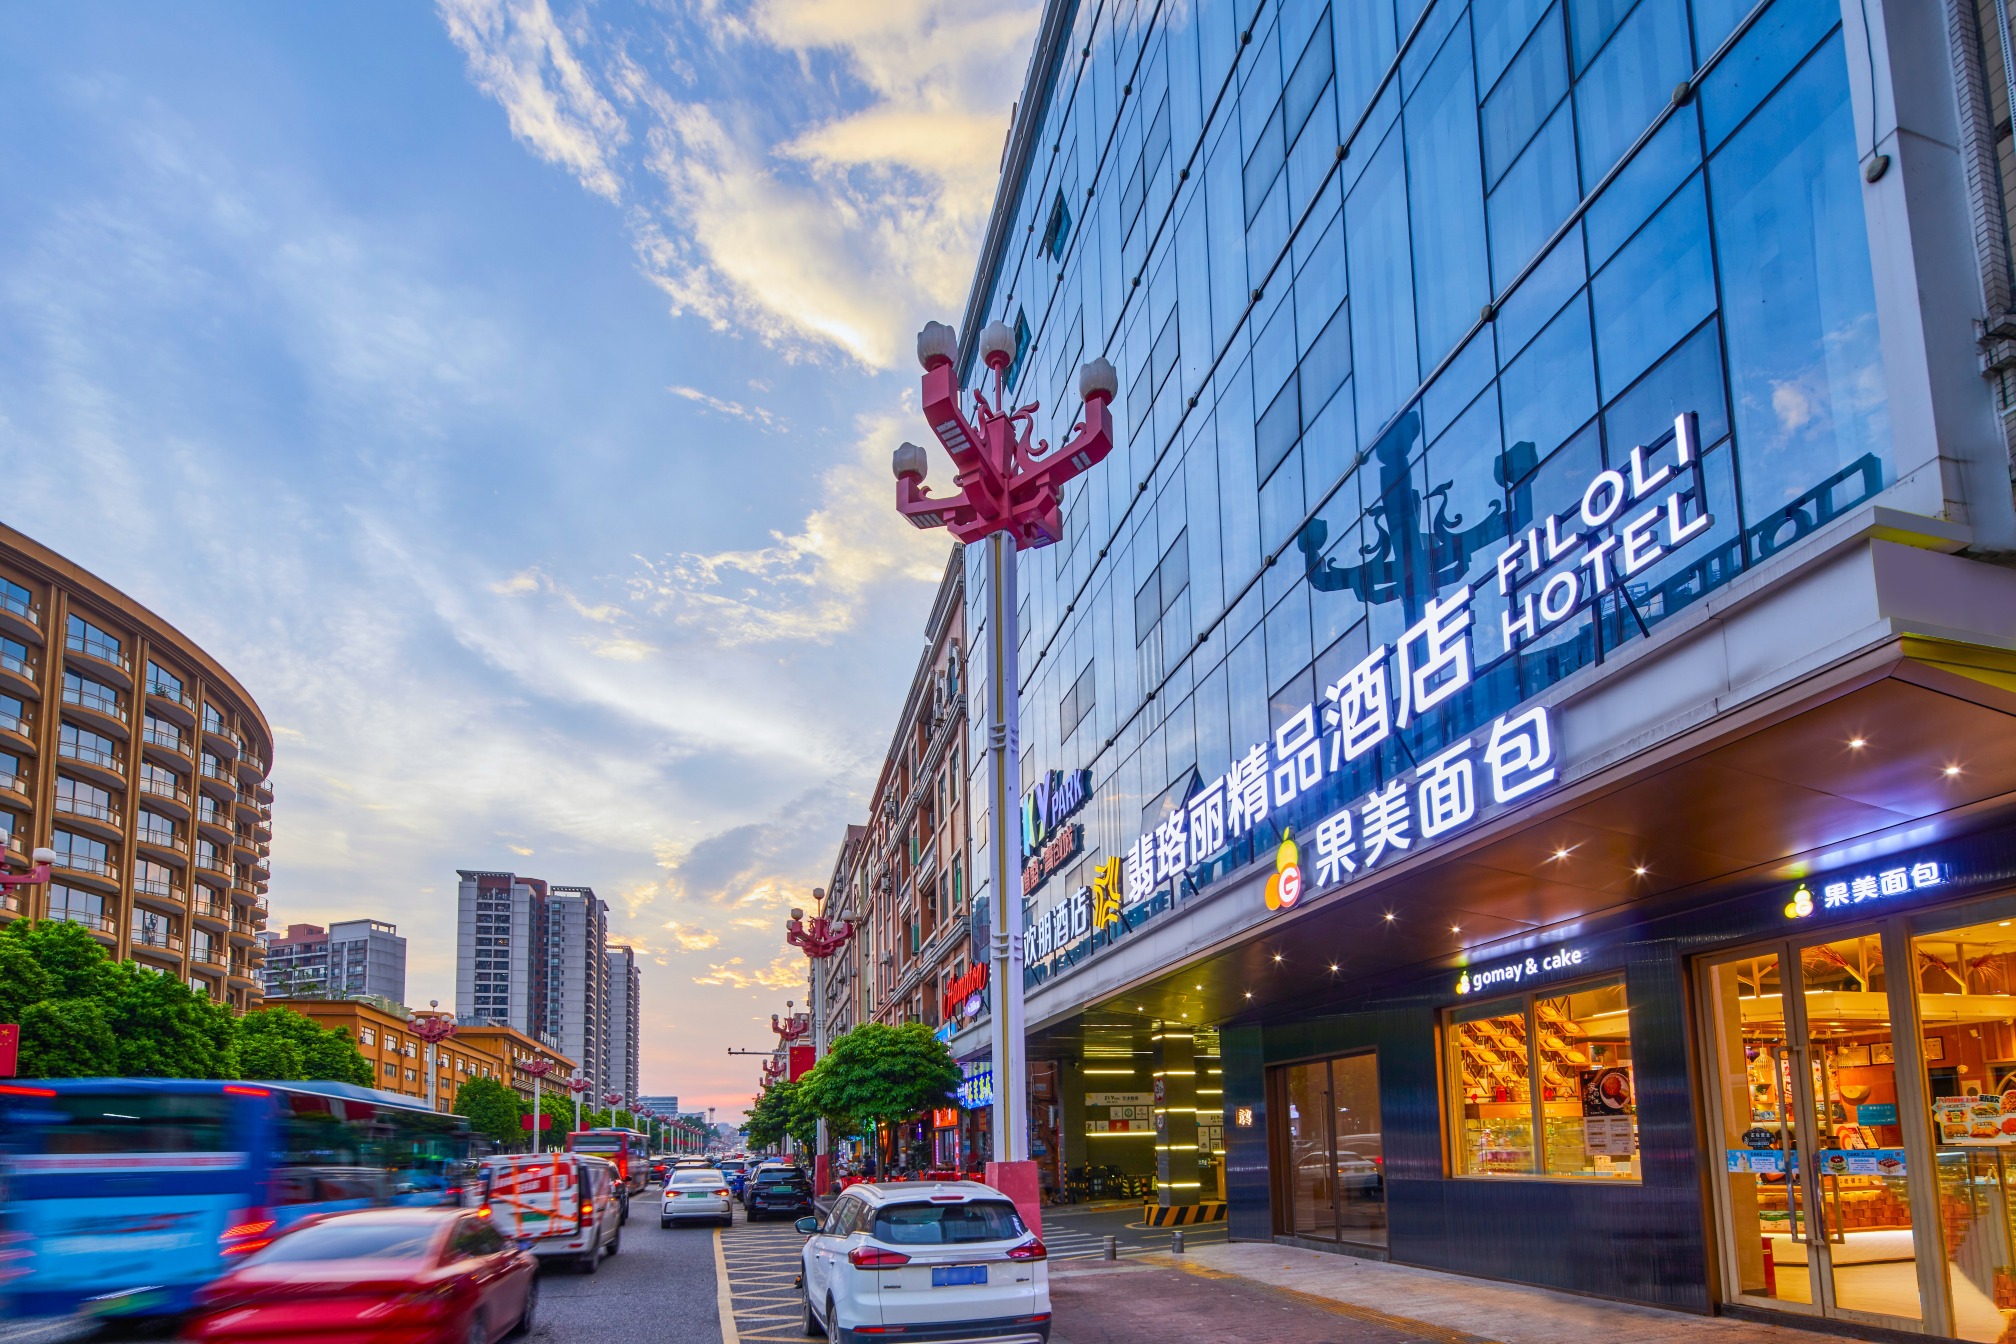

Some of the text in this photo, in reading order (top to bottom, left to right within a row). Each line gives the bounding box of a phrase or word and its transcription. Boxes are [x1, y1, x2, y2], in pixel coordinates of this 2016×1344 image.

[1497, 412, 1694, 598] FILOLI
[1501, 492, 1710, 653] HOTEL
[1128, 584, 1474, 903] 翡珞丽精品酒店
[1051, 769, 1084, 828] PARK
[1316, 706, 1557, 888] 果美面包
[1824, 861, 1941, 908] 果美面包
[1023, 886, 1089, 969] 欢朋酒店
[943, 961, 987, 1020] Hampton
[1472, 948, 1582, 992] gomay & cake
